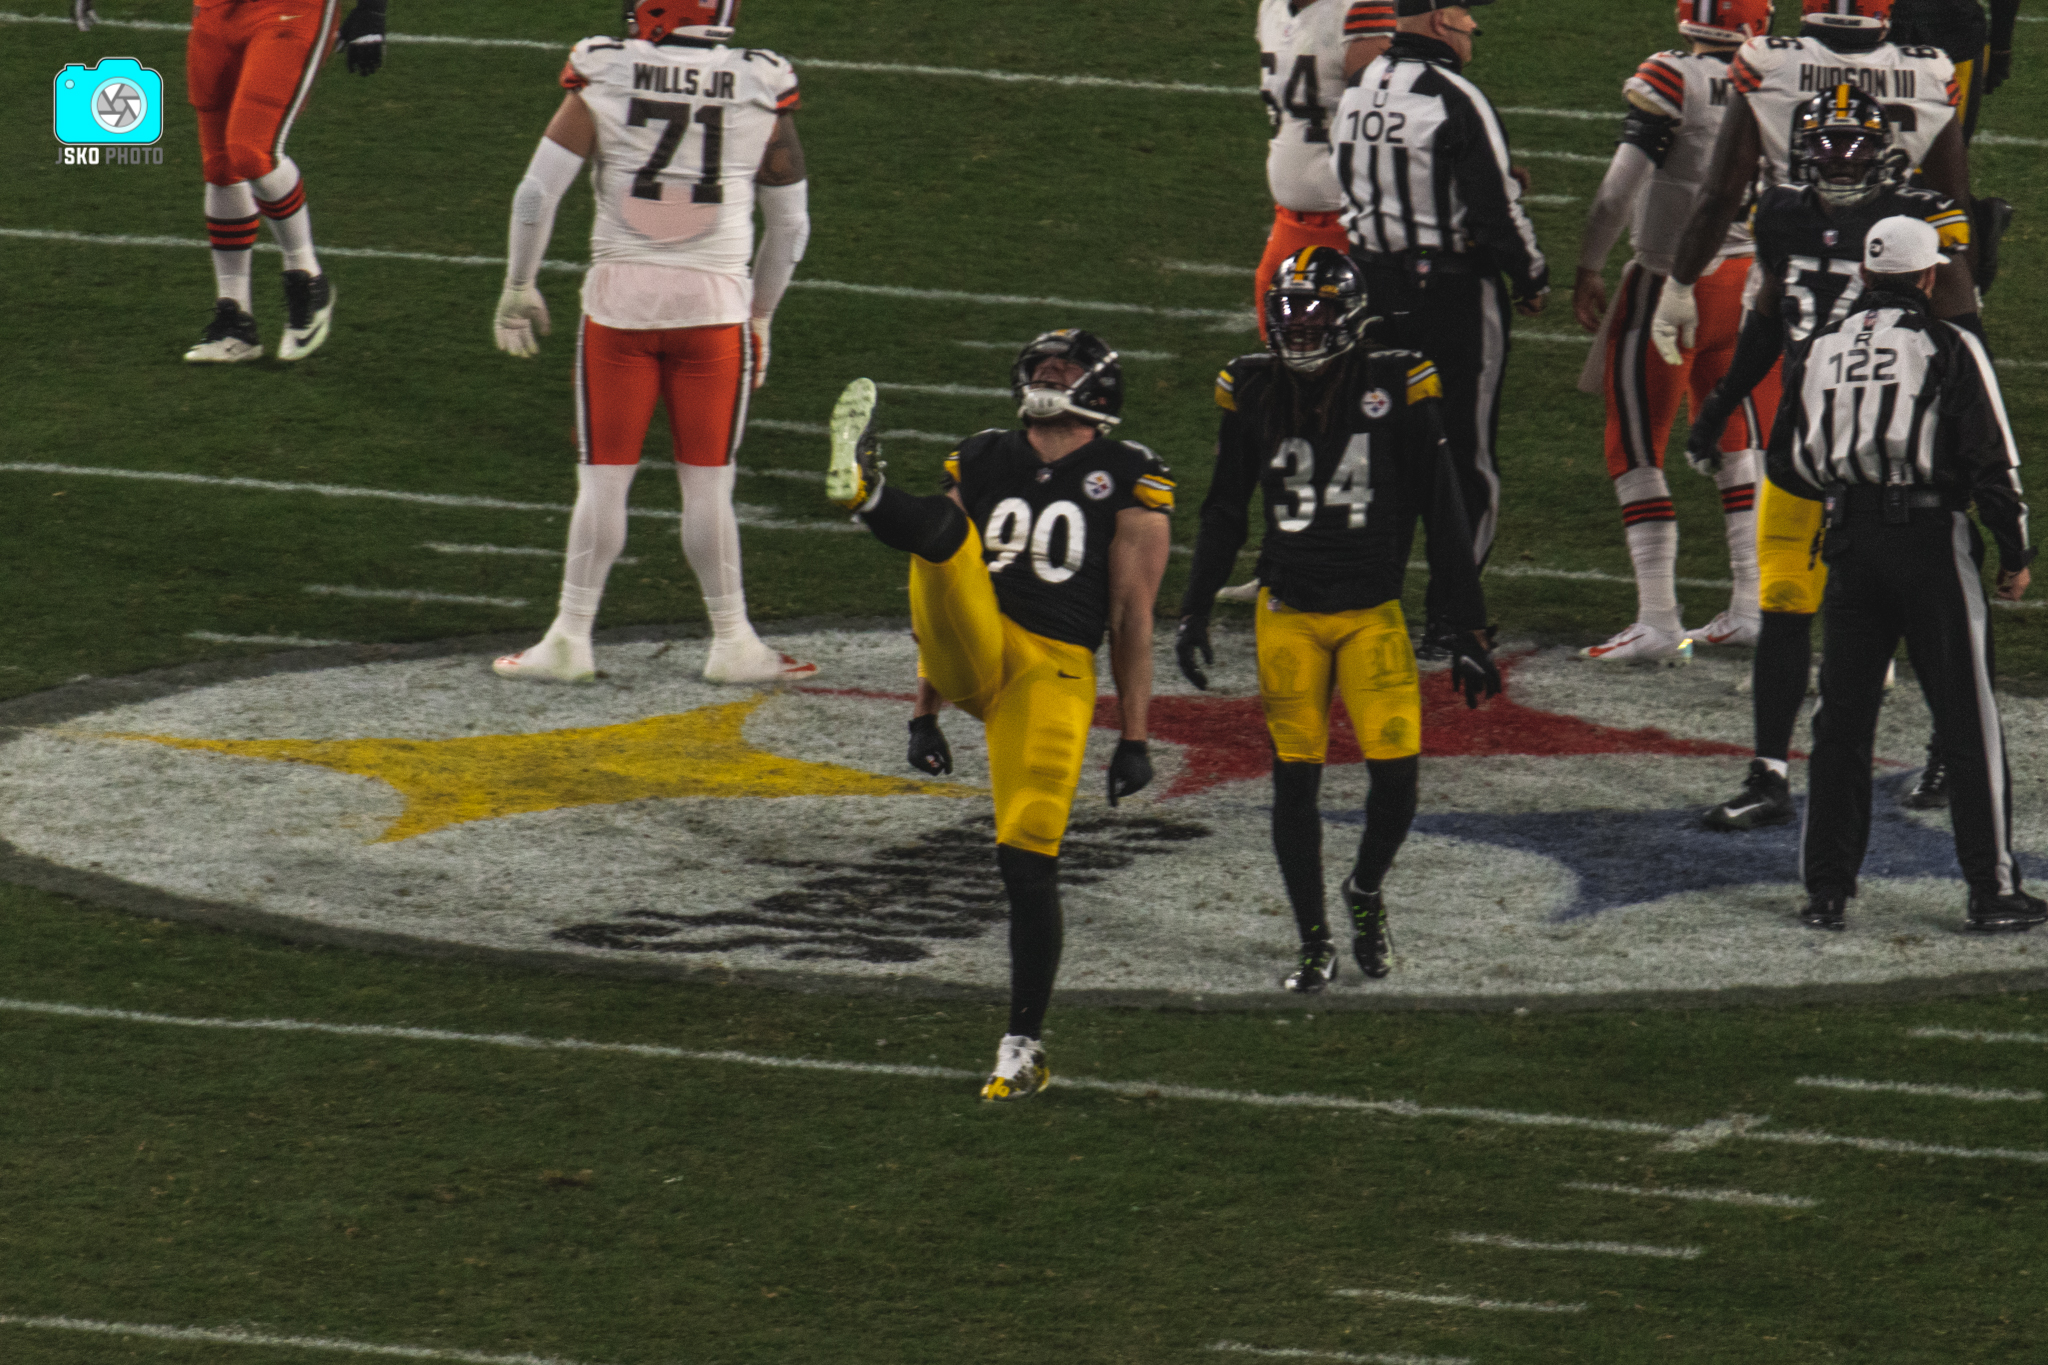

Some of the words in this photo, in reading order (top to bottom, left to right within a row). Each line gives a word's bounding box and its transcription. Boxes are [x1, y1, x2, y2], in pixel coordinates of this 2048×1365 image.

[632, 62, 699, 96] WILLS
[703, 71, 736, 99] JR
[1893, 69, 1916, 98] III
[1347, 109, 1407, 144] 102
[626, 97, 724, 204] 71
[1784, 254, 1867, 342] 57
[1853, 332, 1874, 348] R
[1828, 347, 1898, 384] 122
[1269, 432, 1375, 533] 34
[983, 496, 1088, 583] 90
